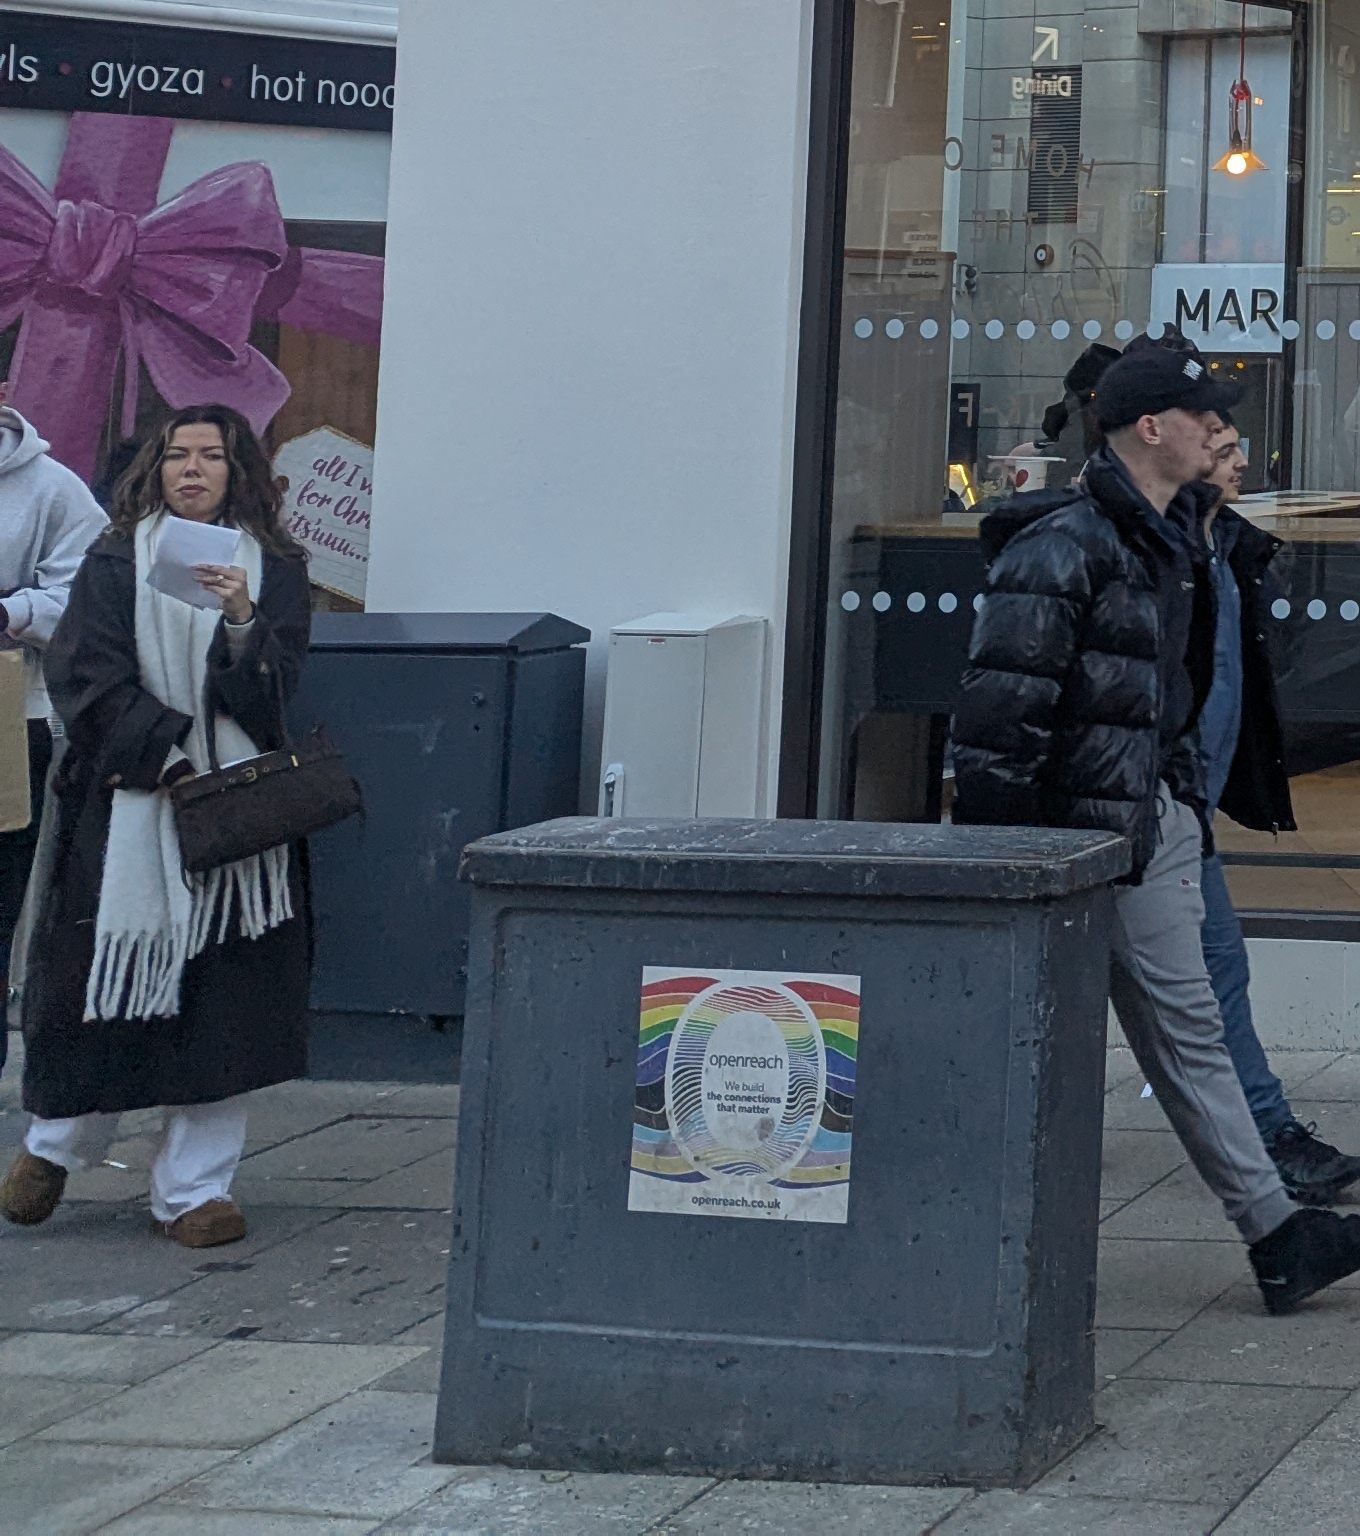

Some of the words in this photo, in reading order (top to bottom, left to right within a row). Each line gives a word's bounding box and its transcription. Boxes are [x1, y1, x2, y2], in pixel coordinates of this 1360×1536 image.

[0, 44, 39, 82] ls
[90, 60, 204, 99] gyoza
[250, 64, 306, 103] hot
[312, 455, 347, 482] all
[343, 464, 362, 487] I
[296, 479, 332, 507] for
[709, 1054, 783, 1070] openreach
[724, 1080, 740, 1091] We
[742, 1082, 764, 1093] build
[707, 1091, 722, 1101] the
[724, 1093, 781, 1104] connections
[716, 1102, 736, 1113] that
[738, 1104, 770, 1115] matter
[691, 1195, 781, 1210] openreach.co.uk
